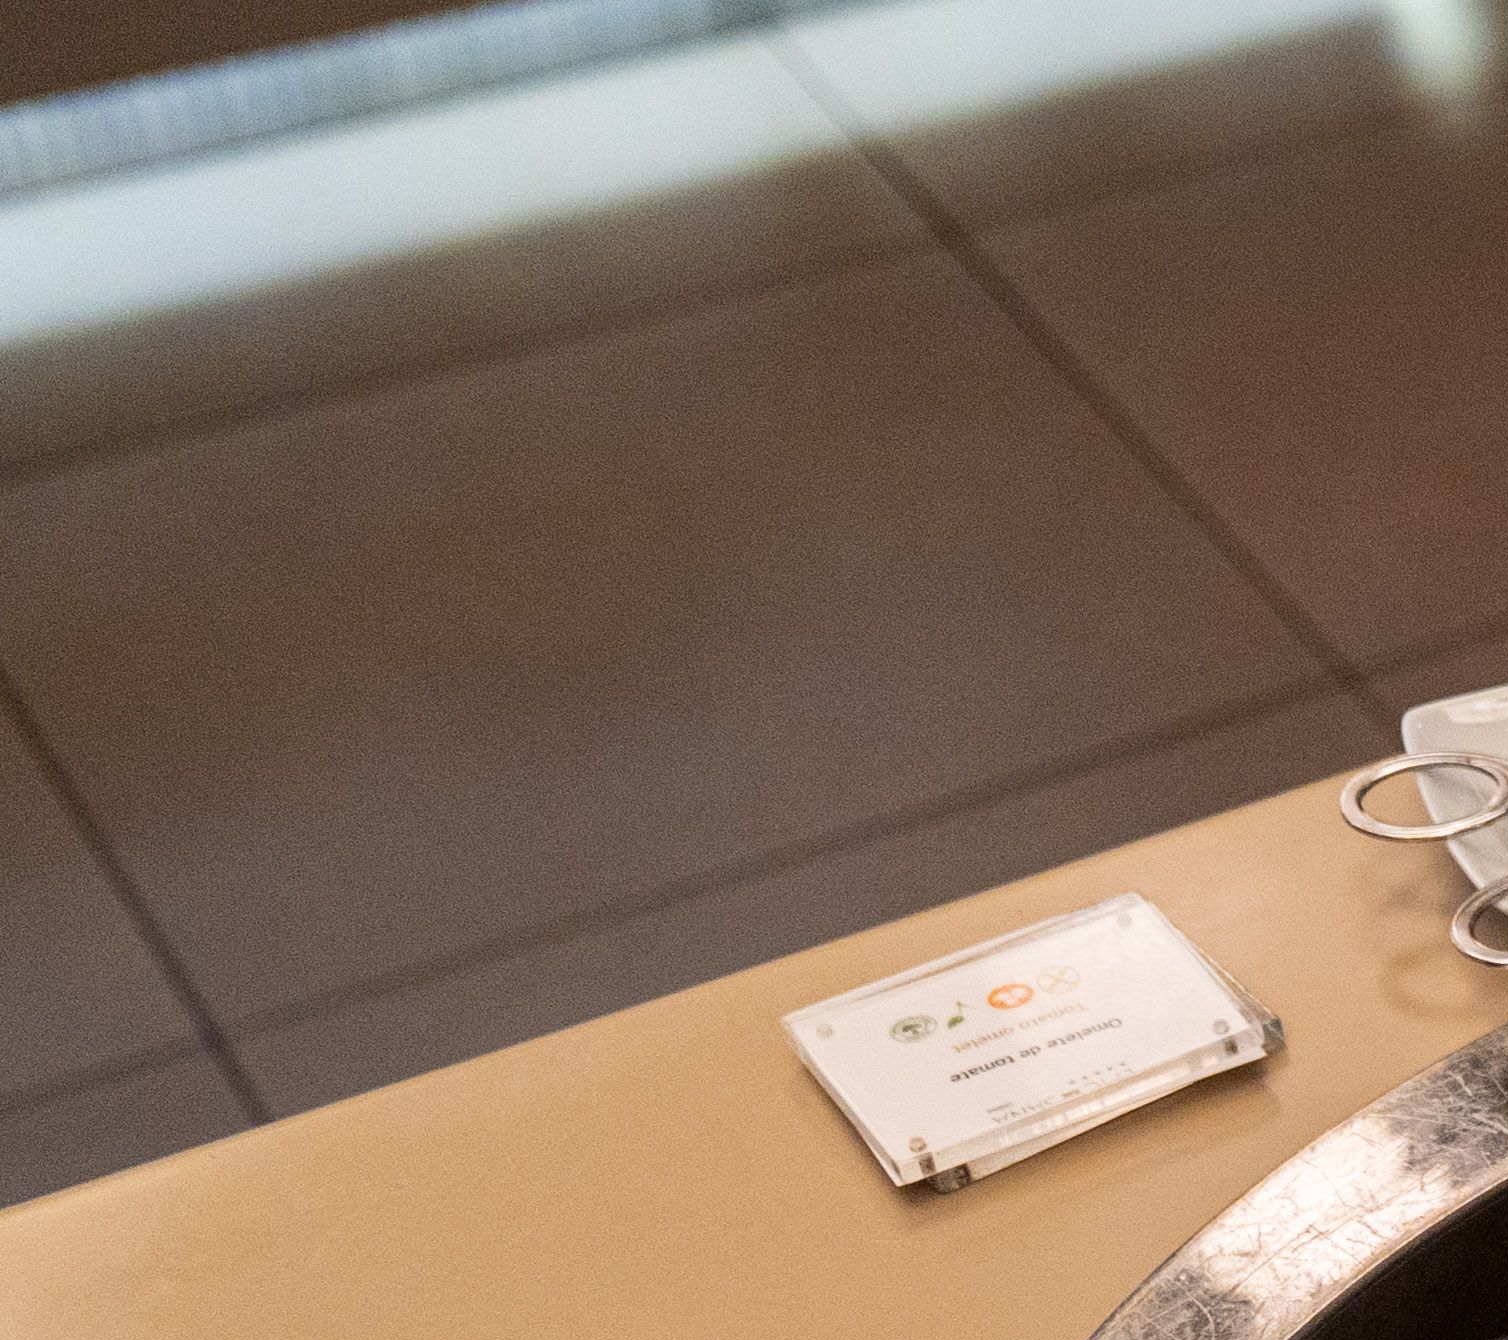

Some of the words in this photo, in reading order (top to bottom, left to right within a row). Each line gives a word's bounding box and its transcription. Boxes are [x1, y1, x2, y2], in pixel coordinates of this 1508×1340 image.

[1047, 1017, 1122, 1049] Omelete
[1019, 1045, 1041, 1058] de
[950, 1054, 1016, 1083] tomate
